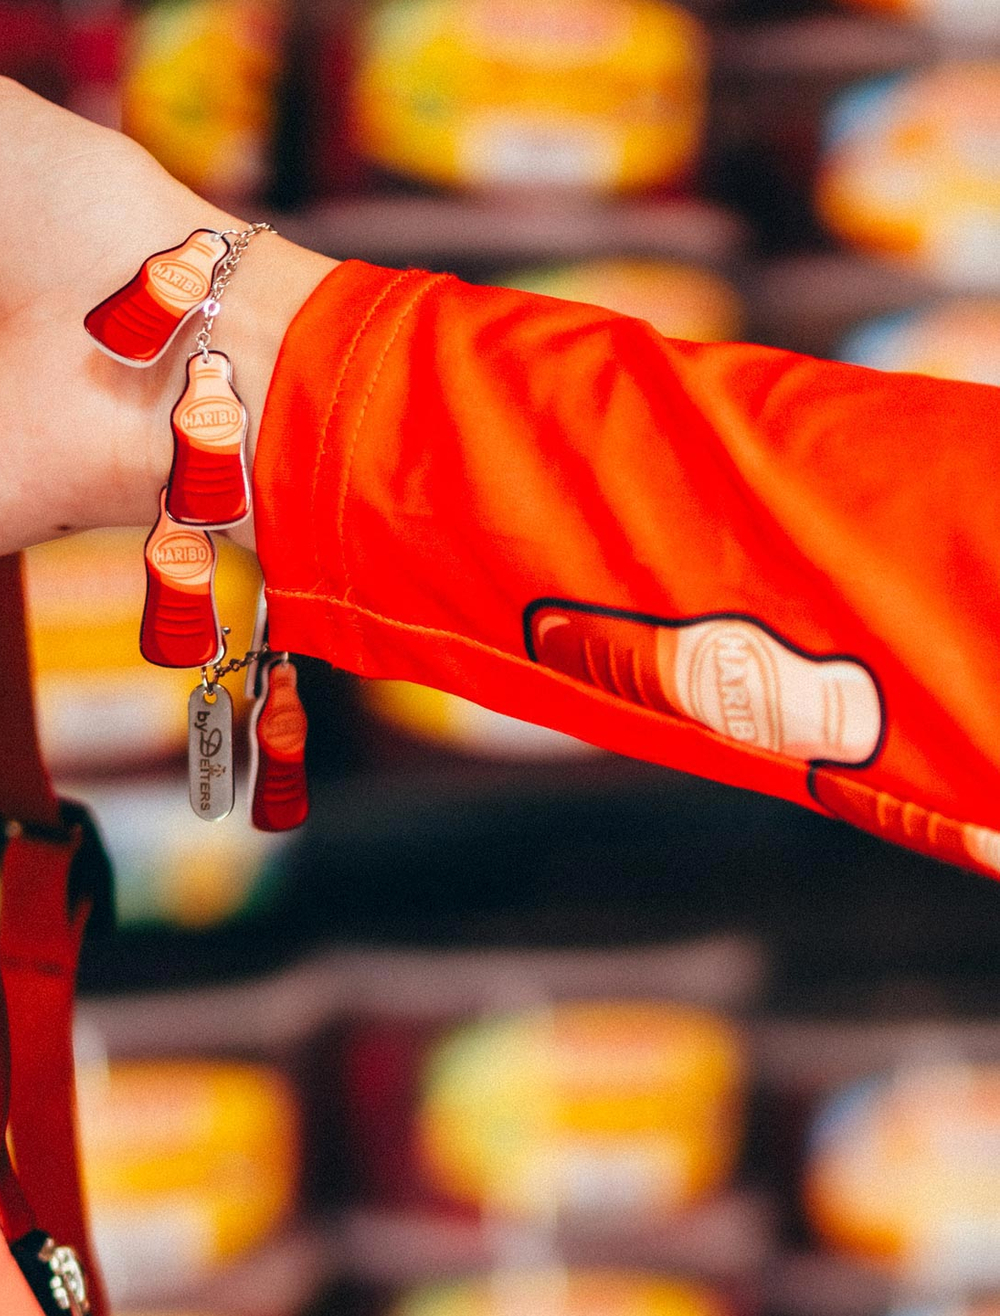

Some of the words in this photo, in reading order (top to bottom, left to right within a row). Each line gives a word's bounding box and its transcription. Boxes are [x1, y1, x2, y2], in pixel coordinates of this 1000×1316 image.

[154, 262, 203, 297] HARIBO
[184, 409, 240, 429] HARIBO
[155, 549, 209, 565] HARIBO
[718, 636, 757, 743] HARIB
[194, 711, 211, 733] by
